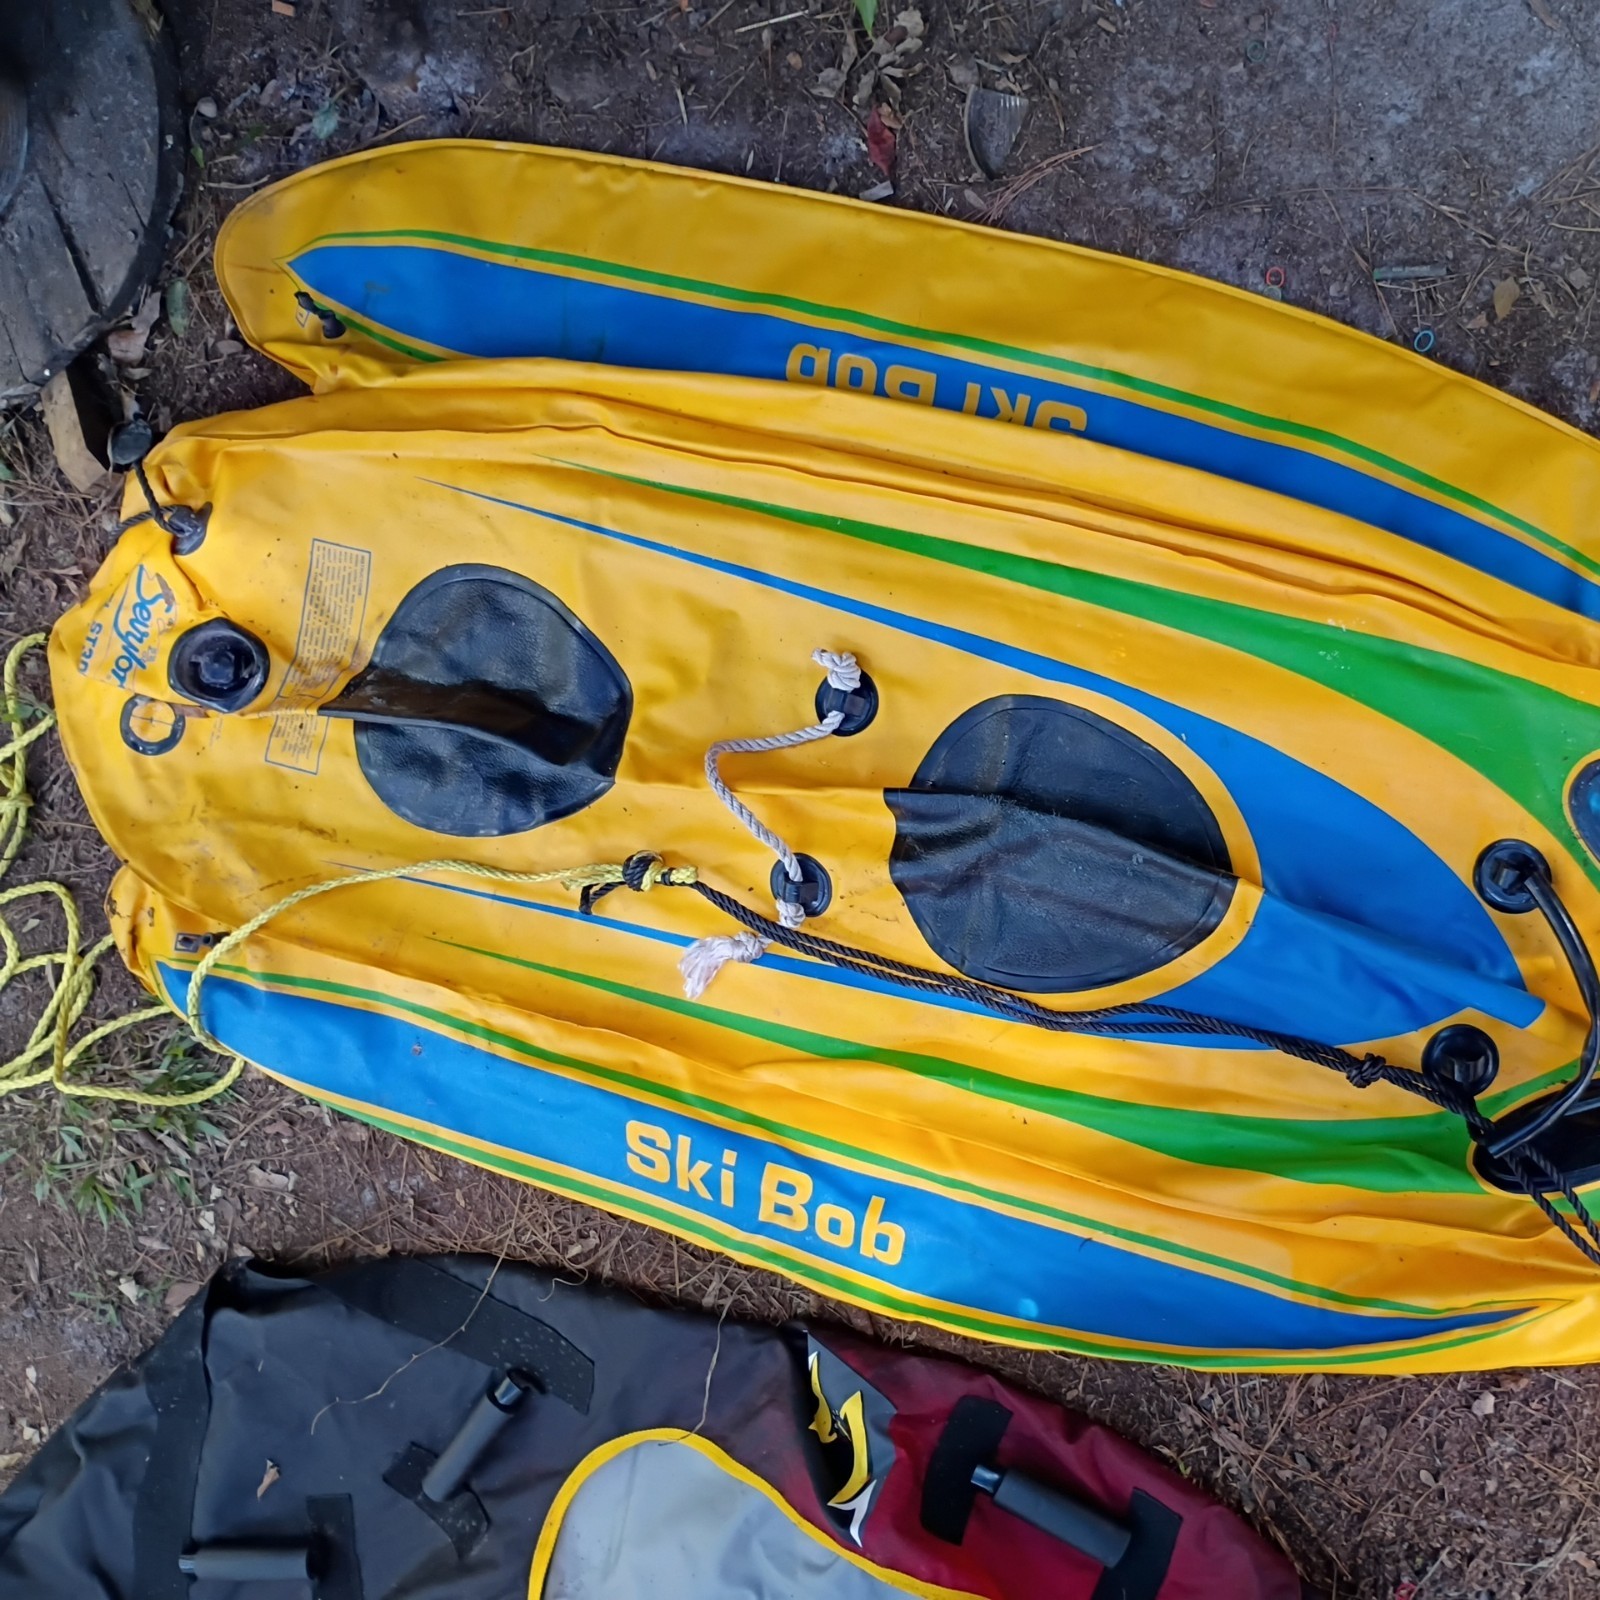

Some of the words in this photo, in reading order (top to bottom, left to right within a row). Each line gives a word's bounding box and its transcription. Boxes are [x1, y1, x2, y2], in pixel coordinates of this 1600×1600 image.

[112, 564, 173, 688] Sevylor
[625, 1120, 738, 1208] Ski
[758, 1161, 906, 1265] Bob
